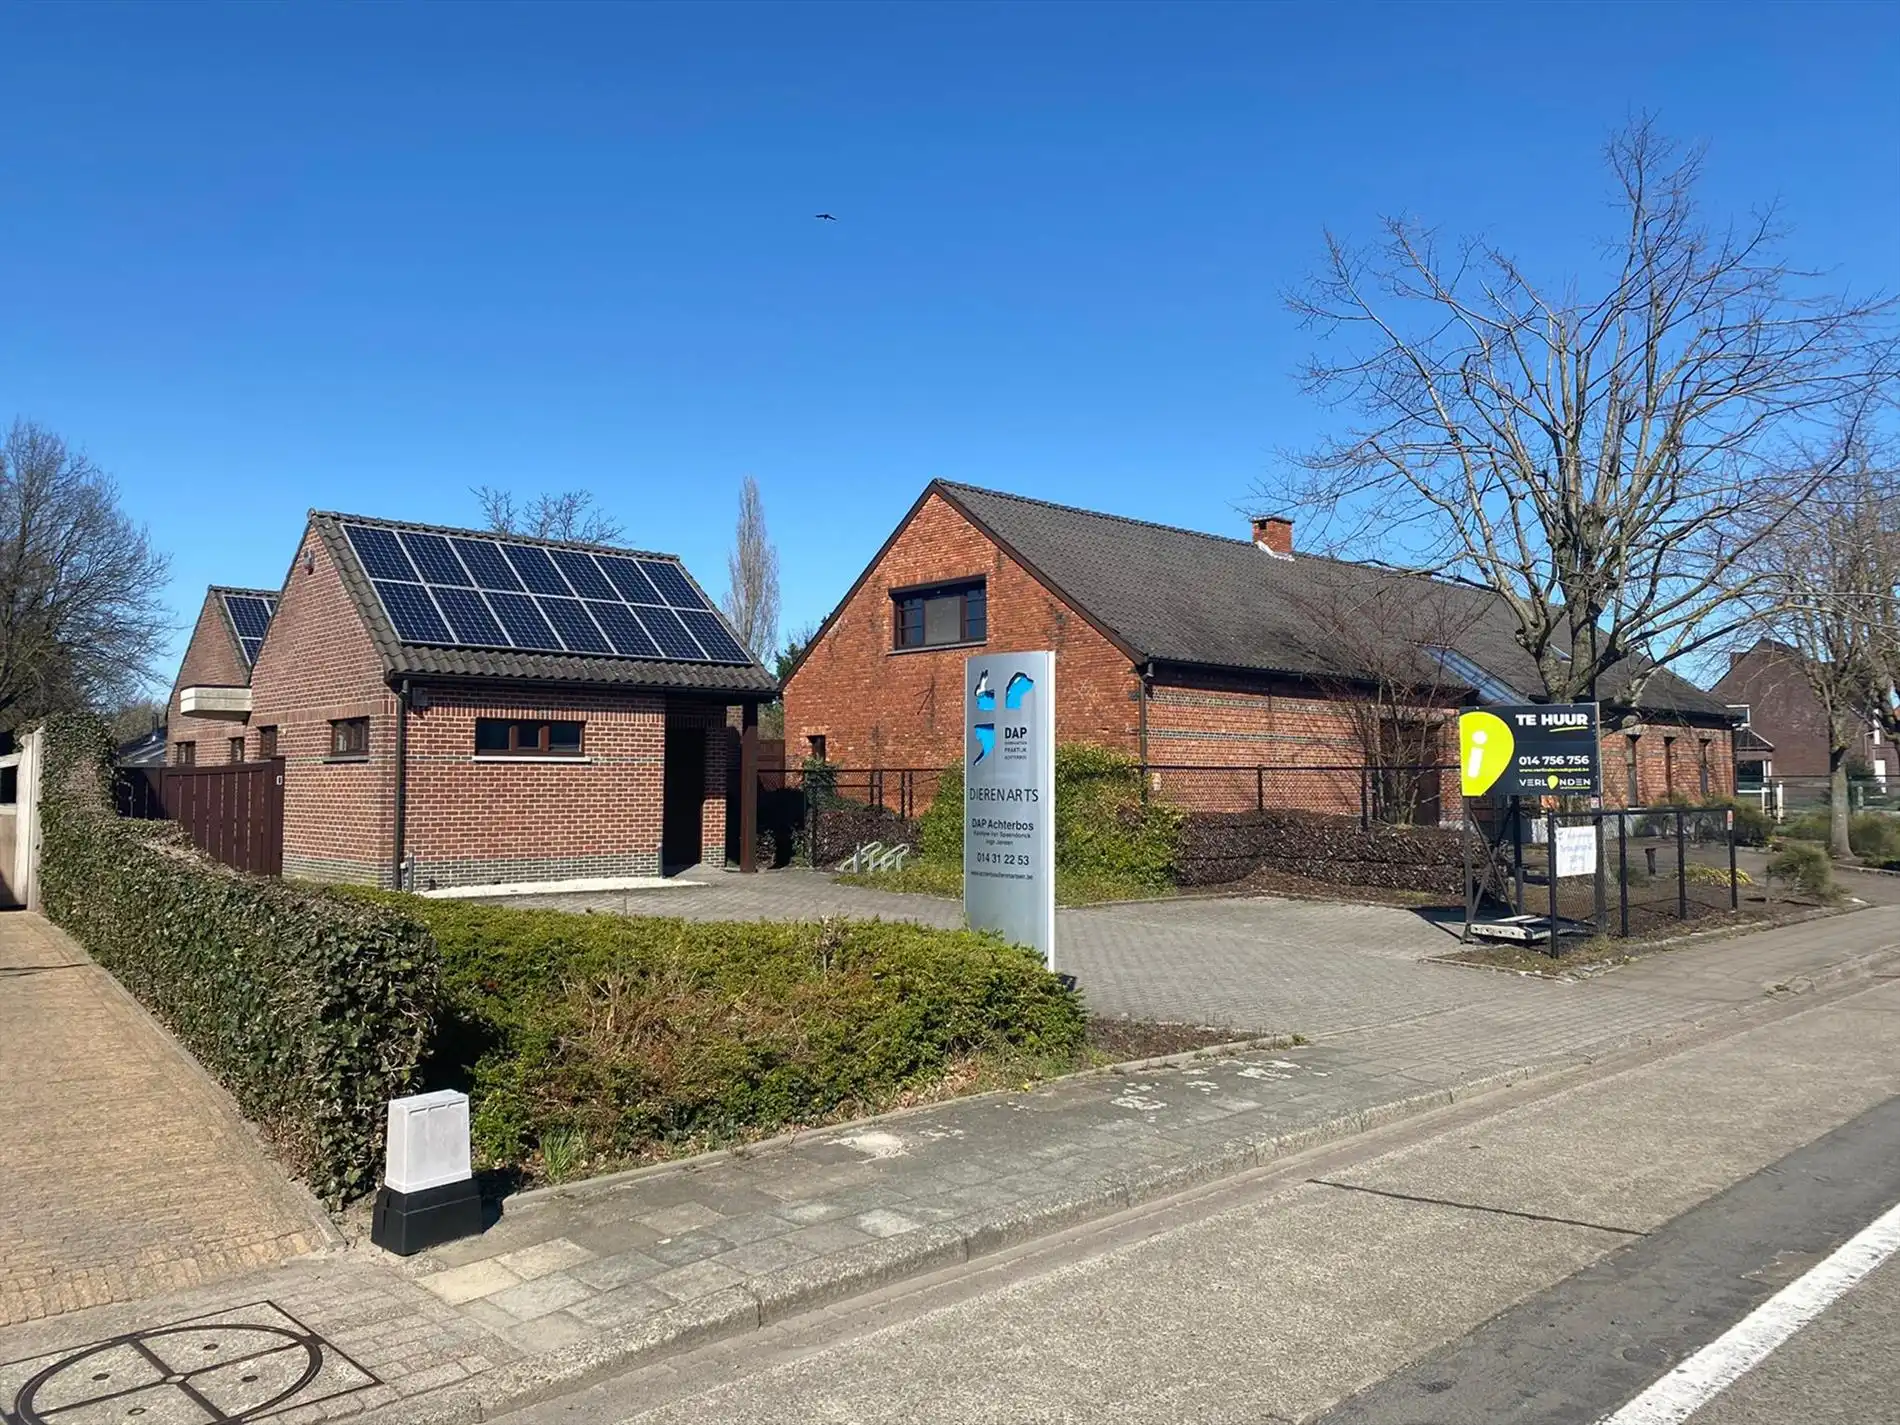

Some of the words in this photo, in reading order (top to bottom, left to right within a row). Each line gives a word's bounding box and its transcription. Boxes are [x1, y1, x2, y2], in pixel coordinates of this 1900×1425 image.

[1515, 714, 1537, 726] TE
[1541, 713, 1589, 726] HUUR
[1004, 727, 1028, 739] DAP
[1518, 756, 1540, 766] 014
[1542, 755, 1565, 765] 756
[1566, 755, 1590, 765] 756
[1519, 776, 1591, 787] VERLNDEN
[970, 788, 1039, 802] DIERENARTS
[971, 818, 987, 829] DAP
[987, 820, 1034, 831] Achterbos
[977, 852, 990, 863] 014
[991, 853, 1001, 864] 31
[1004, 854, 1015, 865] 22
[1017, 855, 1030, 866] 53
